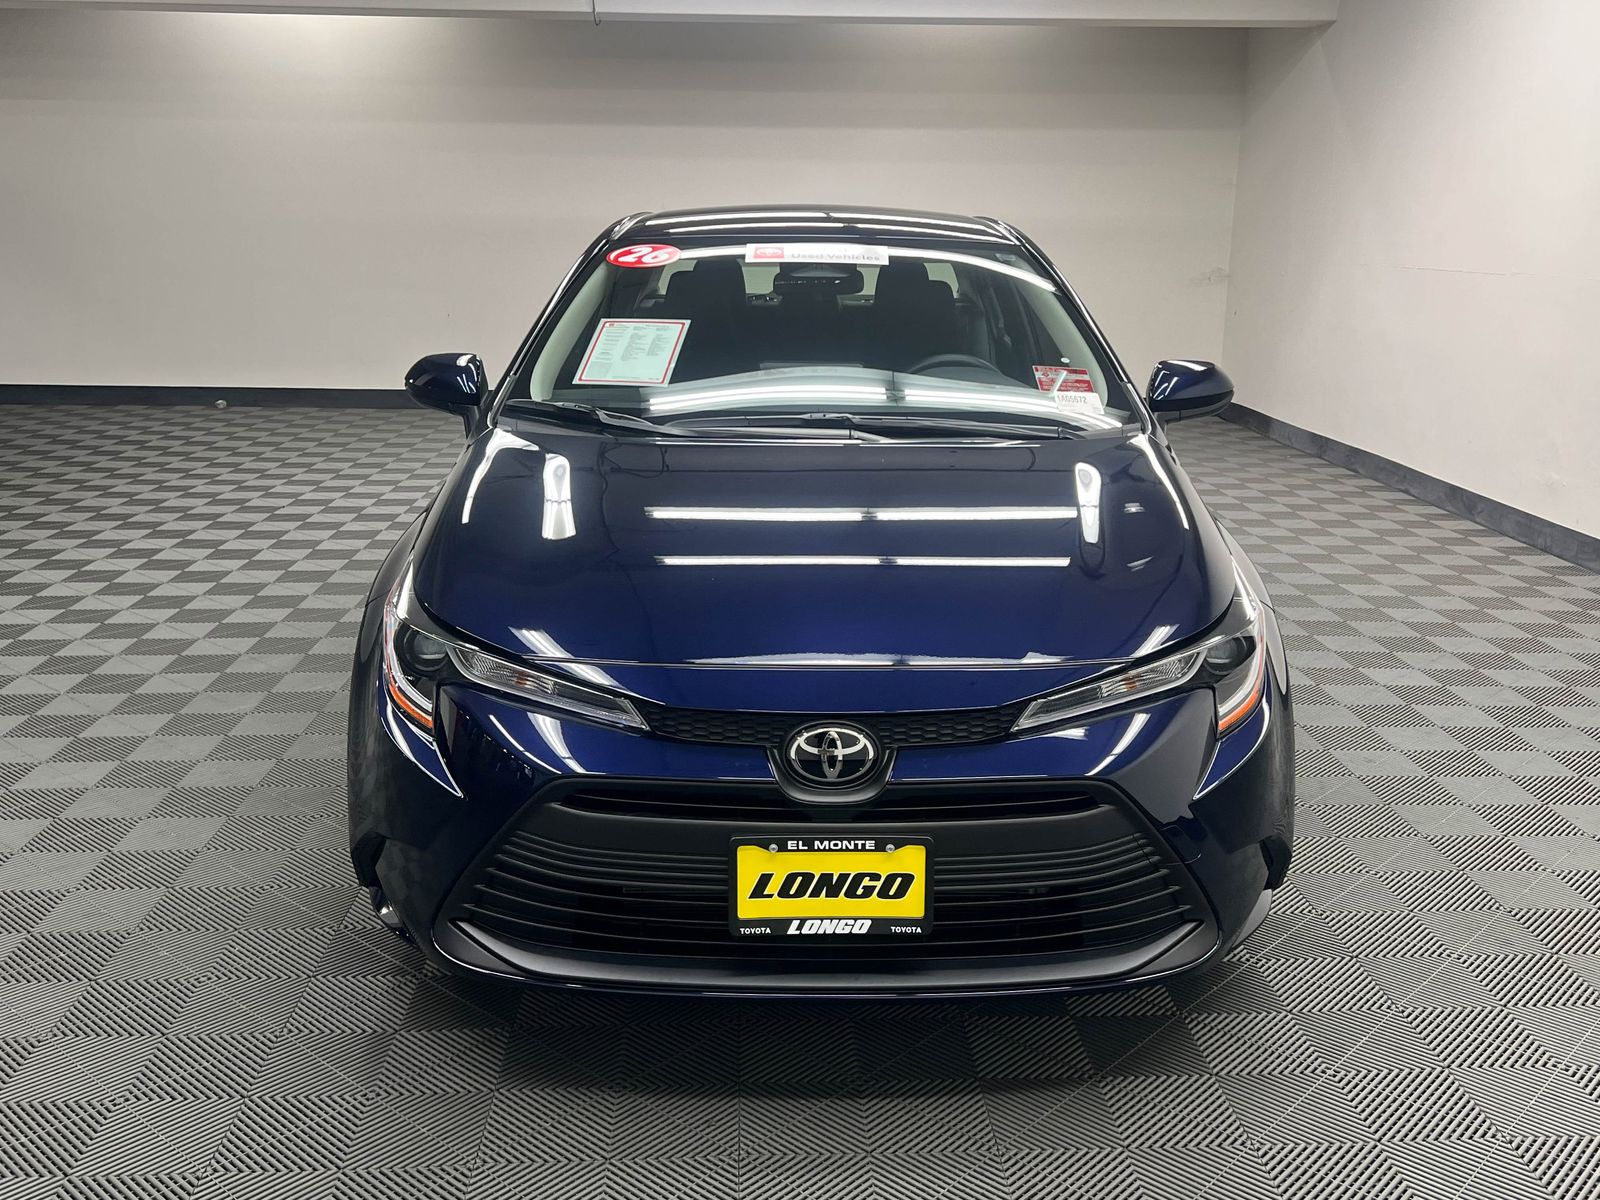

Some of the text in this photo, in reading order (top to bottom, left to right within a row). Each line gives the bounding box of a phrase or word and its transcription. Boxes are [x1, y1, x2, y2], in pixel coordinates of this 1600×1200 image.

[617, 246, 674, 264] 26
[827, 253, 881, 261] Vehicles
[787, 840, 876, 850] EL MONTE
[748, 872, 916, 900] LONGO
[740, 927, 771, 935] TOYOTA
[786, 919, 872, 935] LONGO
[890, 926, 922, 934] TOYOTA
